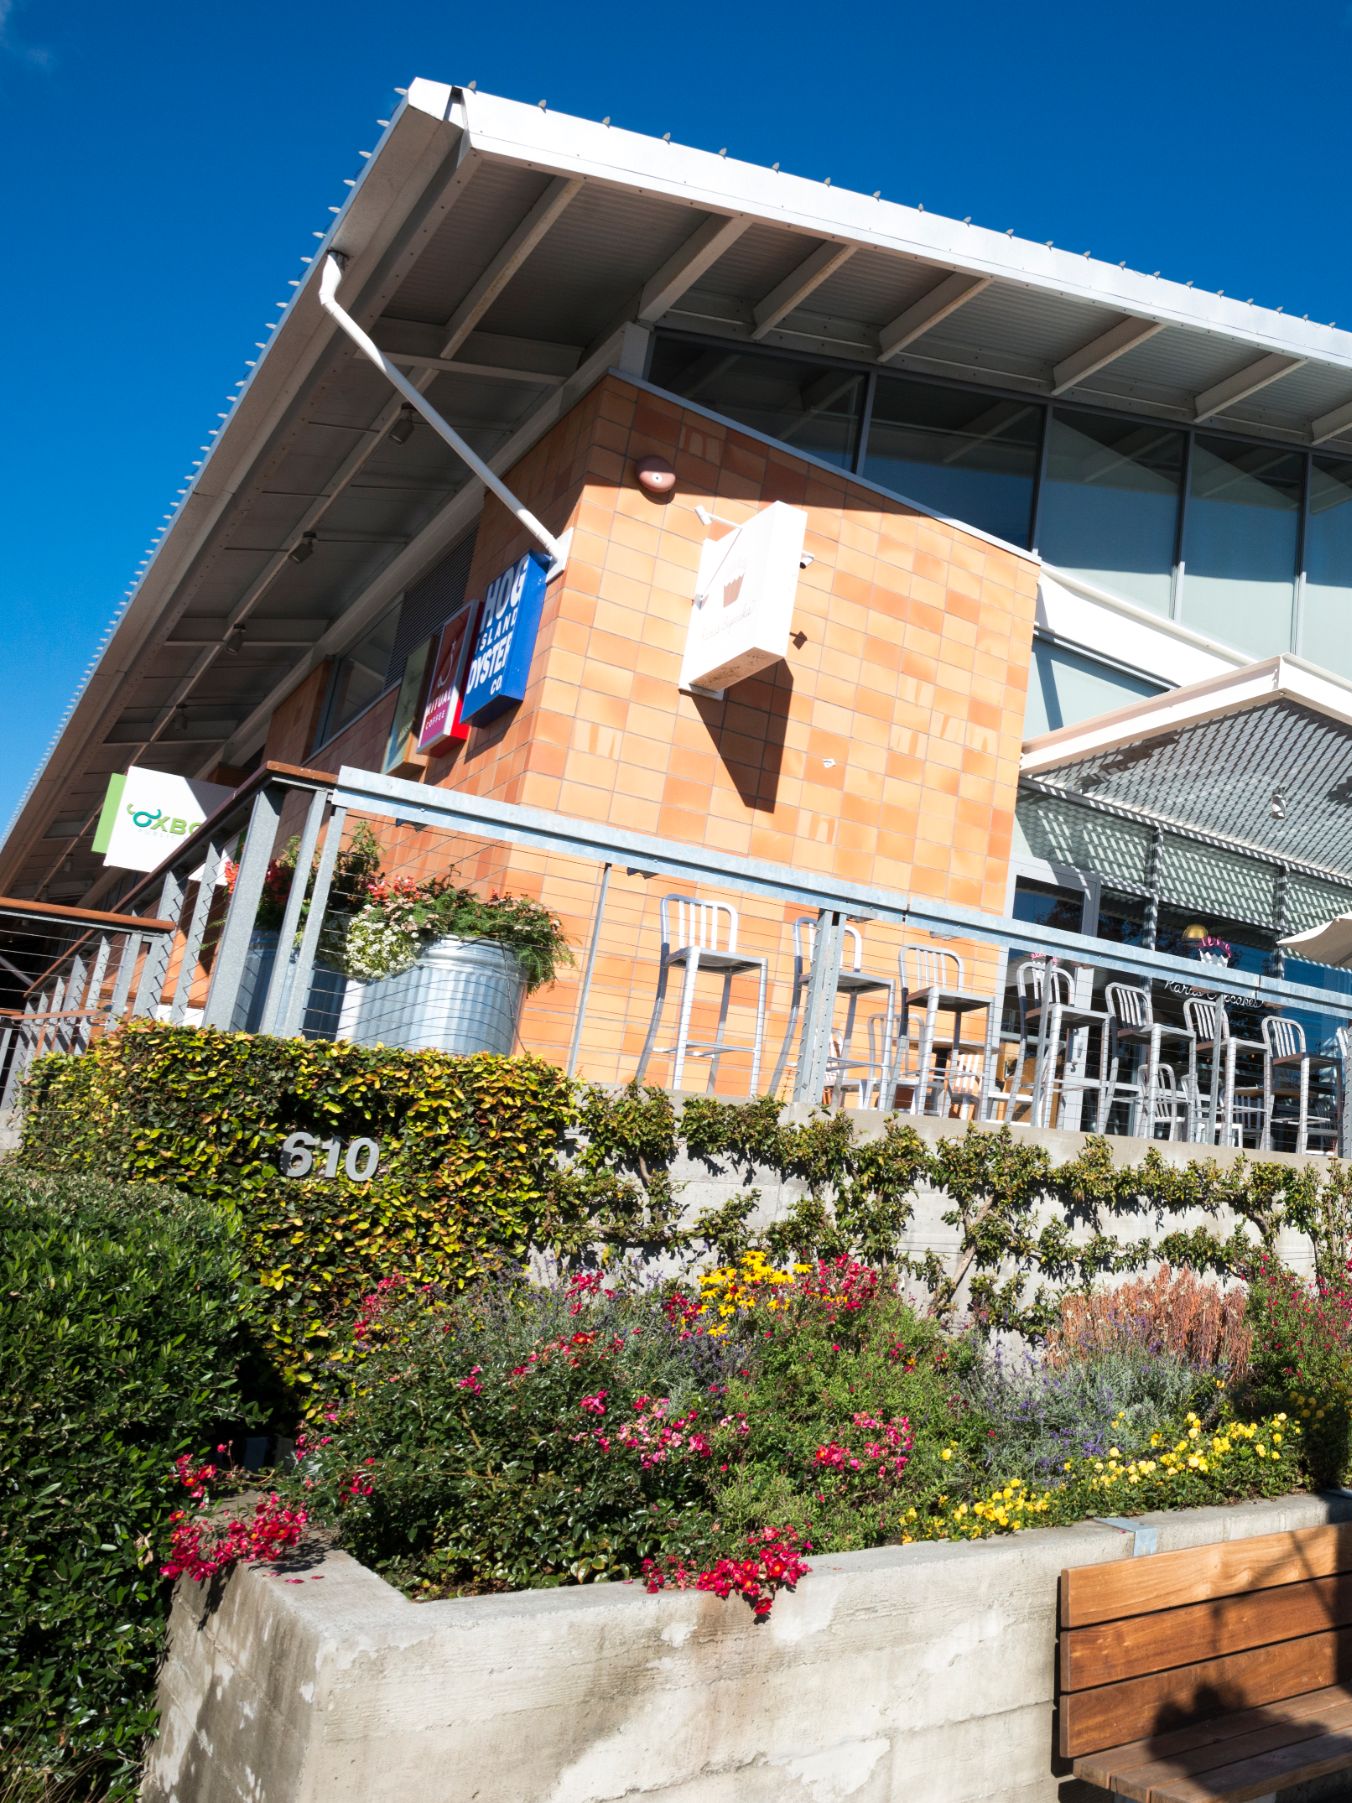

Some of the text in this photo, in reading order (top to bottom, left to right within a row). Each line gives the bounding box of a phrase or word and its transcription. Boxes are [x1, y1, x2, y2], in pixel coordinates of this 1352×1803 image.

[480, 555, 529, 631] HOG
[475, 608, 519, 654] ISLAND
[425, 710, 446, 731] COFFEE
[279, 1131, 380, 1182] 610
